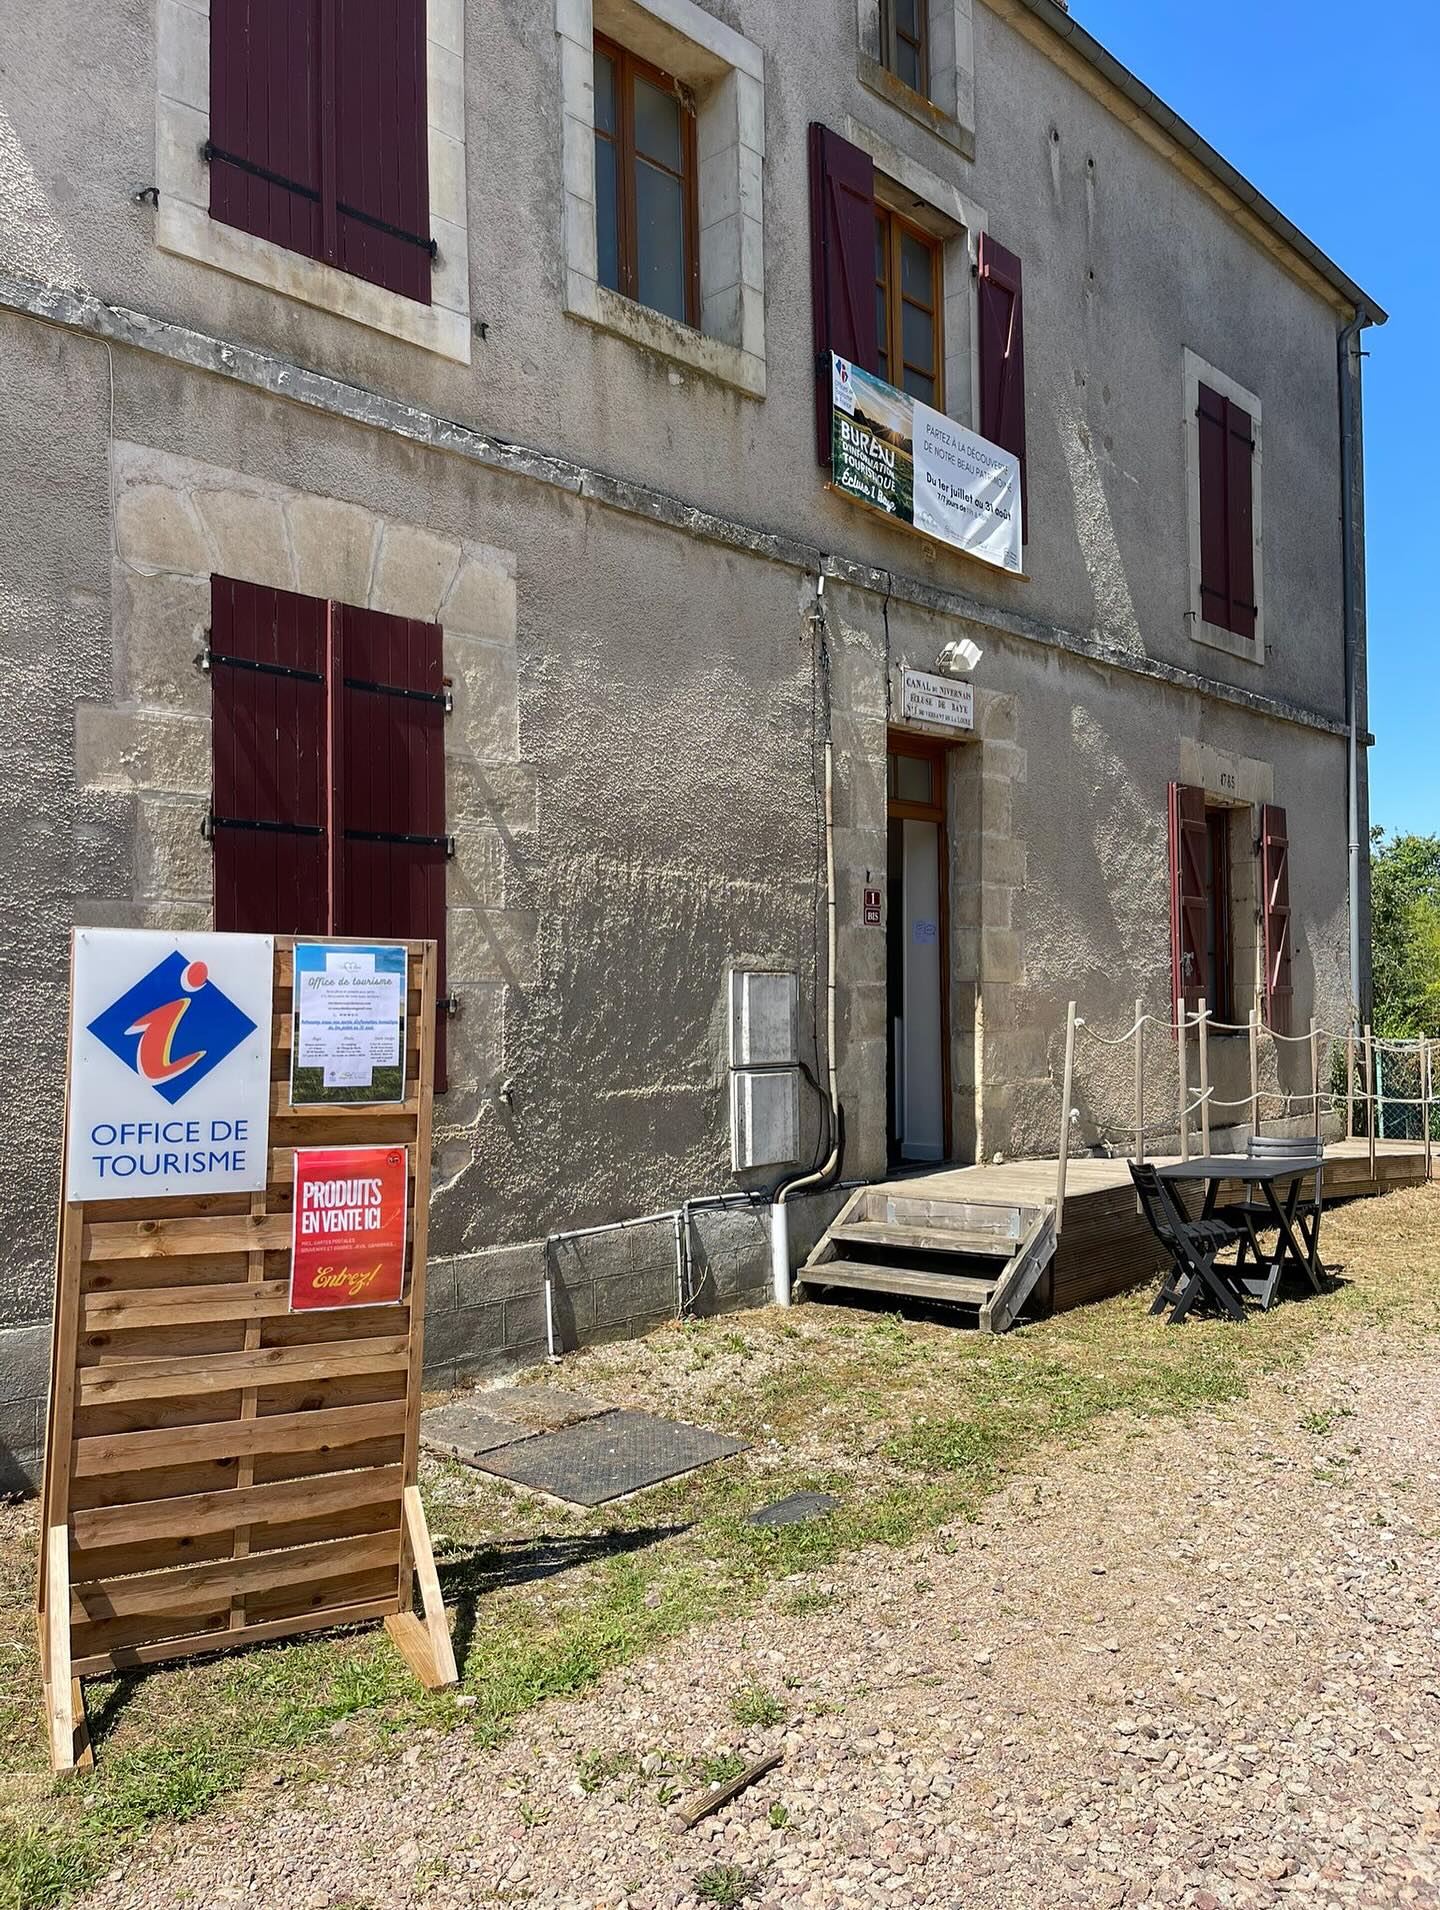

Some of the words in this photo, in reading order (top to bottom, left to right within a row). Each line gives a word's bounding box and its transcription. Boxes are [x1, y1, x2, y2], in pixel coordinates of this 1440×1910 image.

[841, 420, 895, 469] BUREAU
[926, 424, 950, 446] PARTEZ
[957, 440, 966, 454] LA
[842, 441, 895, 480] D'INFORMATION
[923, 440, 933, 455] DE
[934, 445, 956, 466] NOTRE
[958, 456, 975, 475] BEAU
[842, 452, 897, 493] TOURISTIQUE
[926, 471, 937, 487] Du
[938, 477, 950, 494] 1er
[950, 484, 973, 504] juillet
[974, 497, 984, 509] au
[985, 501, 994, 513] 31
[994, 506, 1012, 521] août
[945, 498, 959, 511] jours
[959, 503, 966, 513] de
[906, 677, 931, 692] CANAL
[940, 686, 972, 701] NIVERNAIS
[937, 700, 946, 710] DE
[871, 892, 875, 905] 1
[867, 911, 879, 921] BIS
[308, 976, 335, 990] Office
[338, 977, 350, 986] de
[352, 977, 393, 986] tourisme
[91, 1121, 200, 1146] OFFICE
[211, 1120, 248, 1142] DE
[92, 1150, 246, 1178] TOURISME
[302, 1178, 382, 1209] PRODUITS
[301, 1211, 320, 1235] EN
[321, 1208, 363, 1233] VENTE
[364, 1207, 381, 1230] ICI
[312, 1263, 383, 1296] Entrez!
